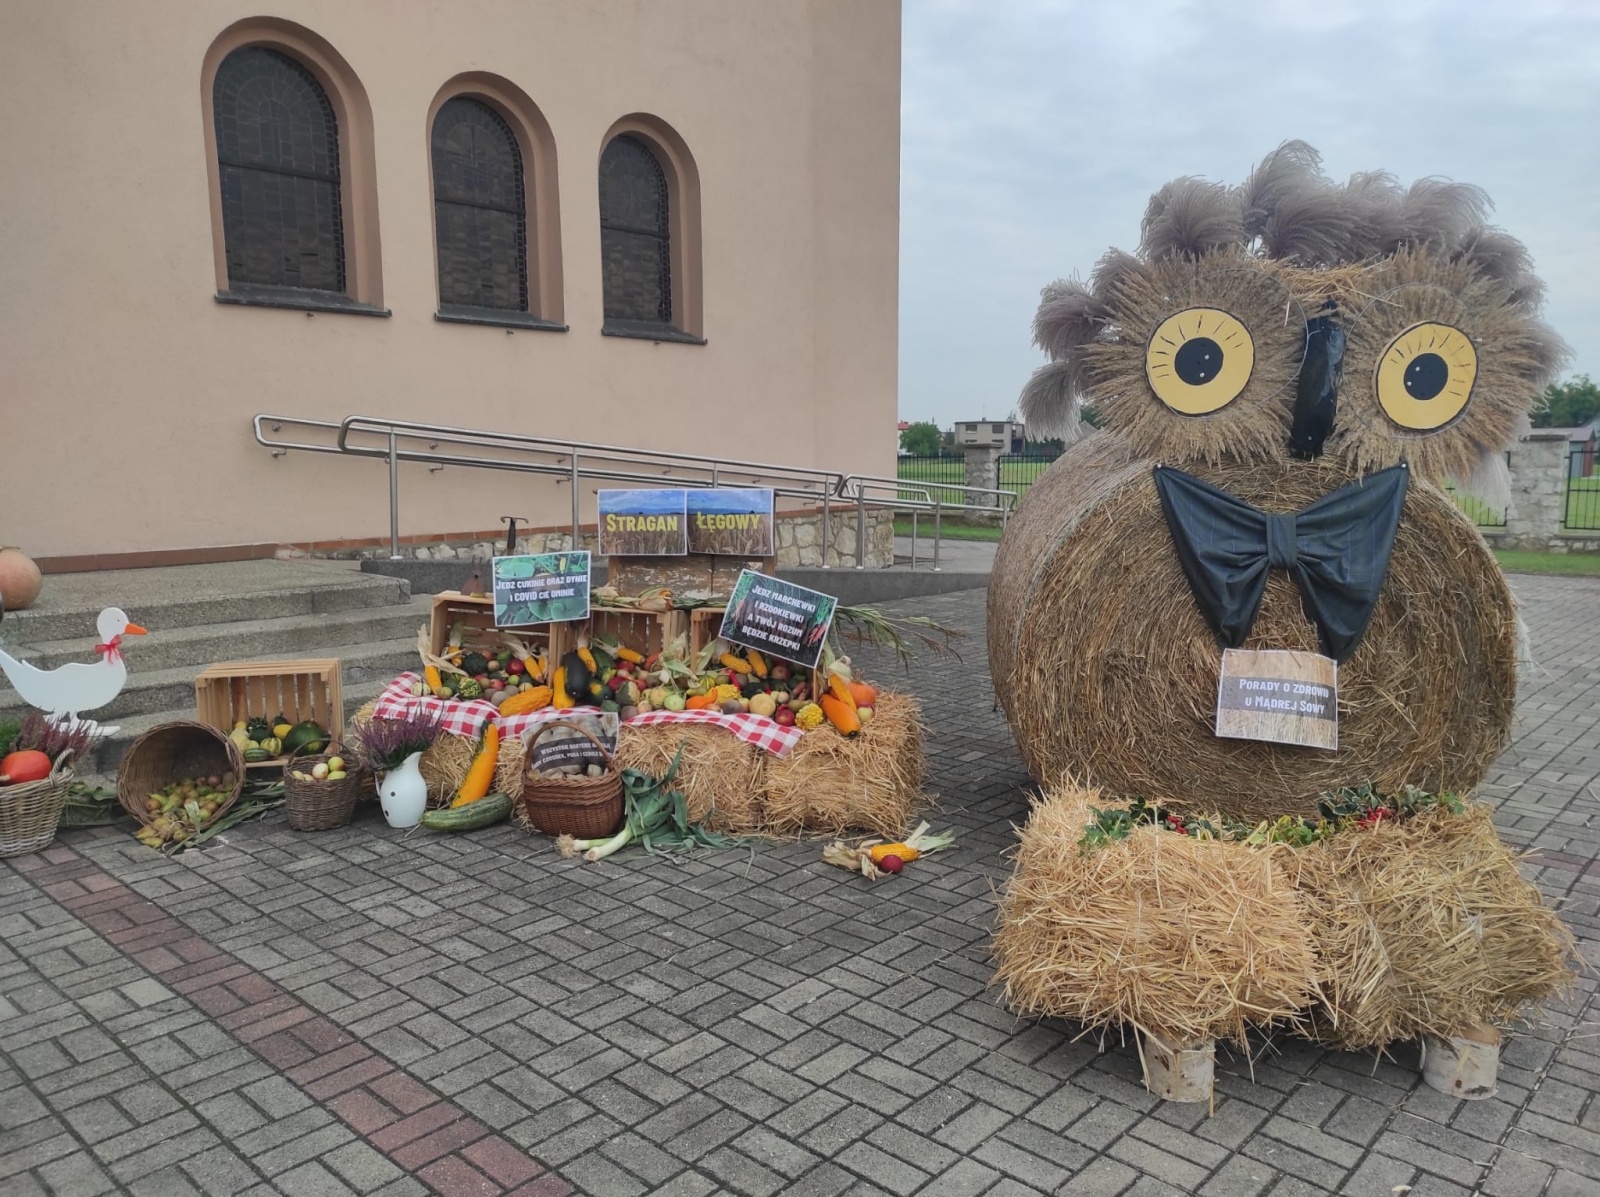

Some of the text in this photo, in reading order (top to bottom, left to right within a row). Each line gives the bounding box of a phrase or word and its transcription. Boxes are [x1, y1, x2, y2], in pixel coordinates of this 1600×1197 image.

[606, 511, 761, 533] STRAGAN ŁĘGOWY
[496, 580, 516, 590] JEDZ
[546, 576, 565, 586] ORAZ
[514, 591, 537, 602] COVID
[751, 584, 816, 613] JEDZ MARCHEWKI
[754, 600, 805, 624] I RZODKIEWKI
[747, 613, 803, 638] A TWÓJ ROZUM
[741, 625, 801, 651] BĘDZIE KRZEPKI
[1239, 678, 1281, 692] PORADY
[1254, 695, 1298, 711] MĄDREJ
[1299, 700, 1325, 715] SOWY
